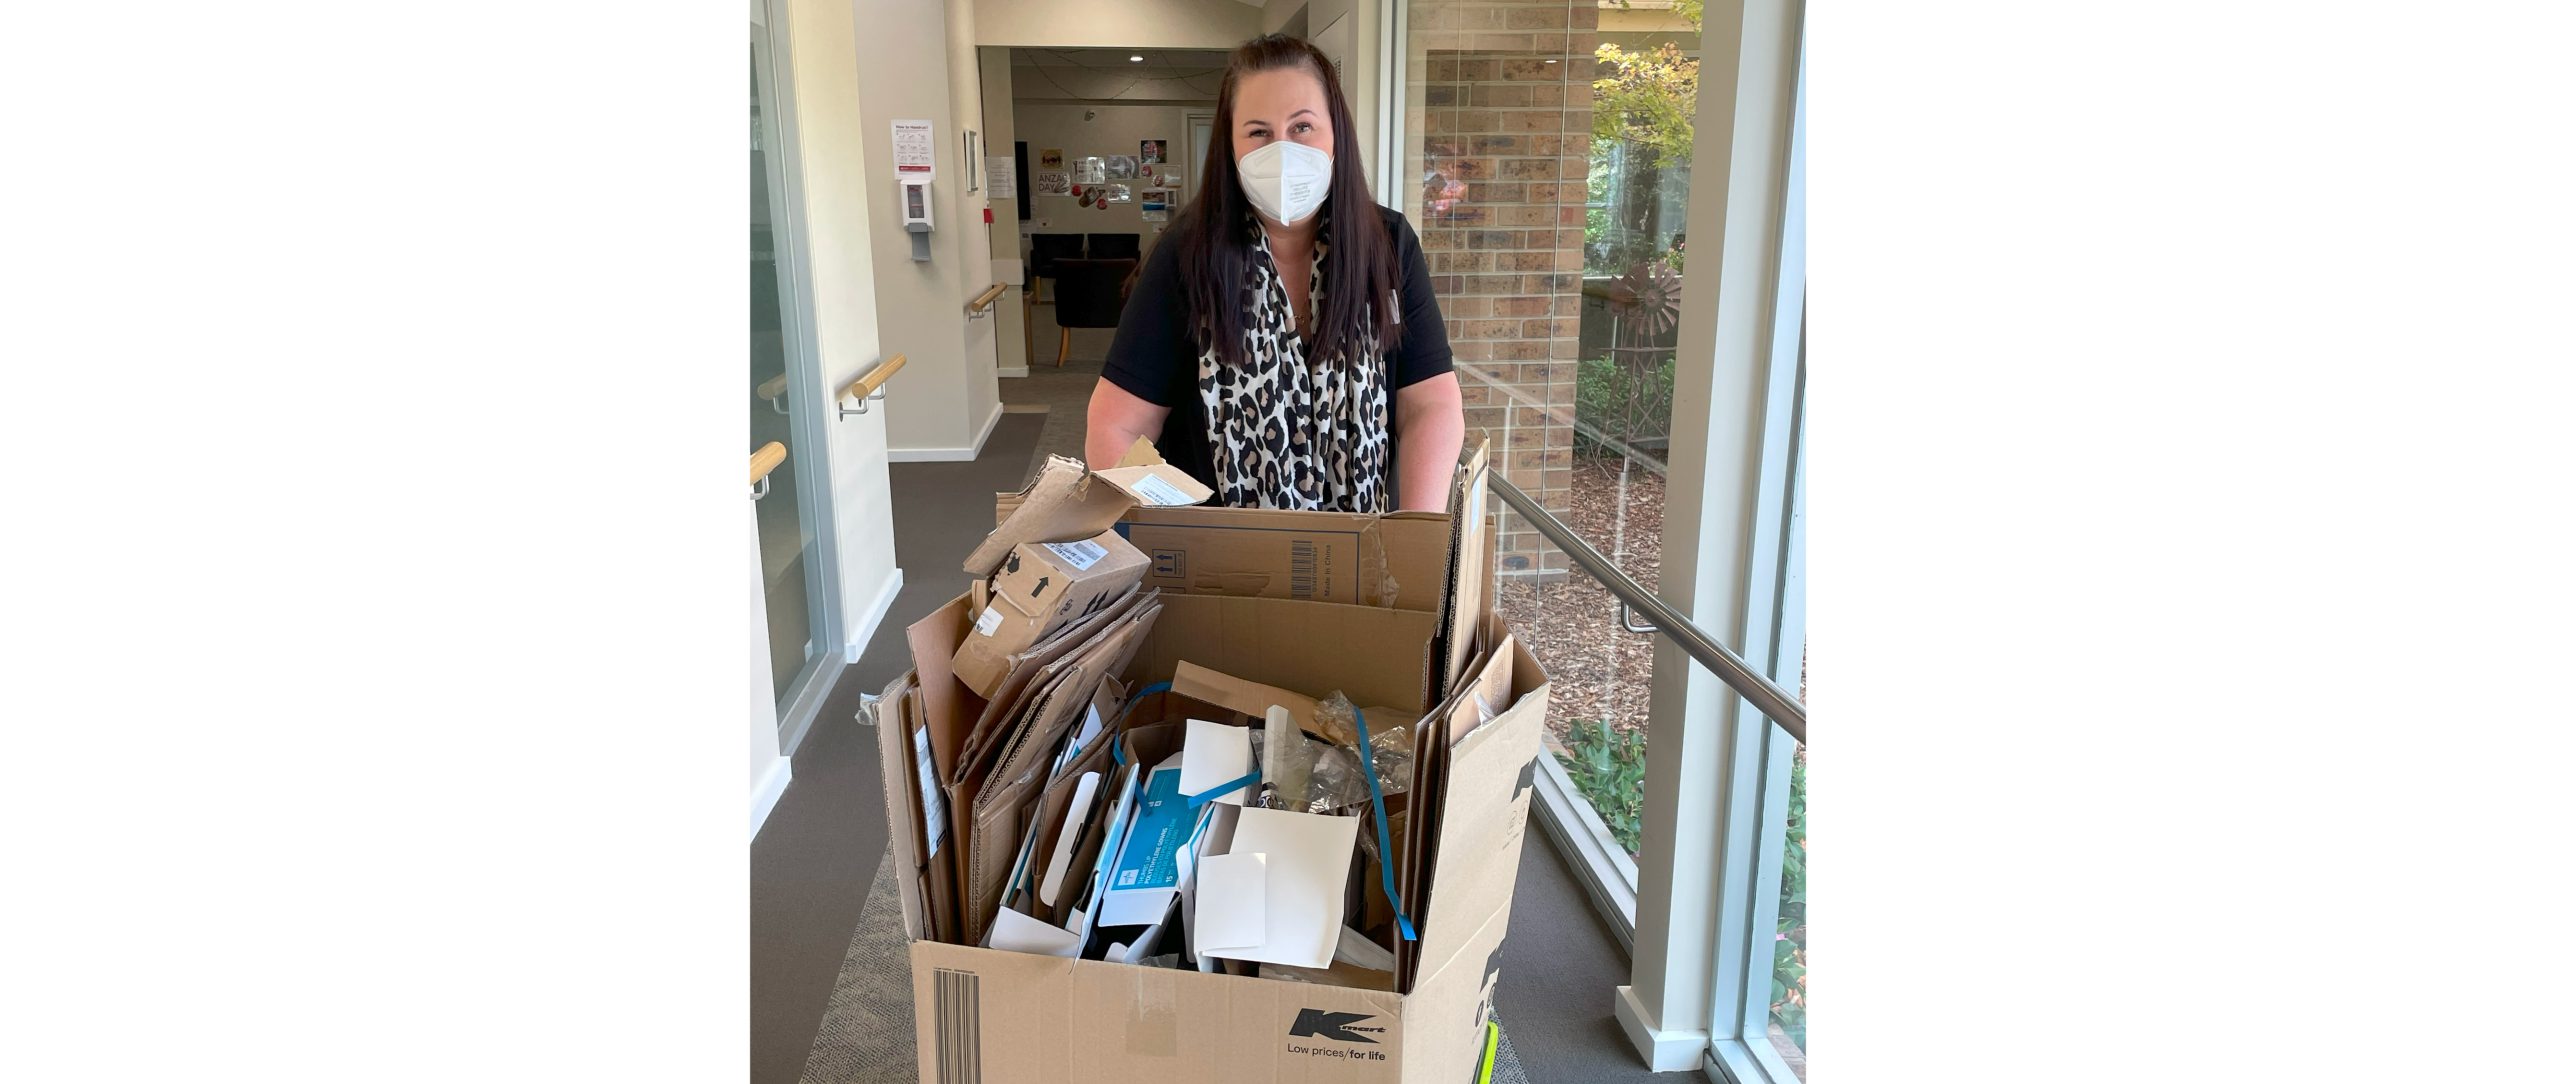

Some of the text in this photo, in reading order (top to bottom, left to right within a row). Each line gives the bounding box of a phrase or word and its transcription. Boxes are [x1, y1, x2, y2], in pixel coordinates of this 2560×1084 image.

[1038, 183, 1055, 192] DAY
[1165, 875, 1173, 883] 15
[1287, 1043, 1309, 1054] Low
[1368, 1050, 1386, 1061] life
